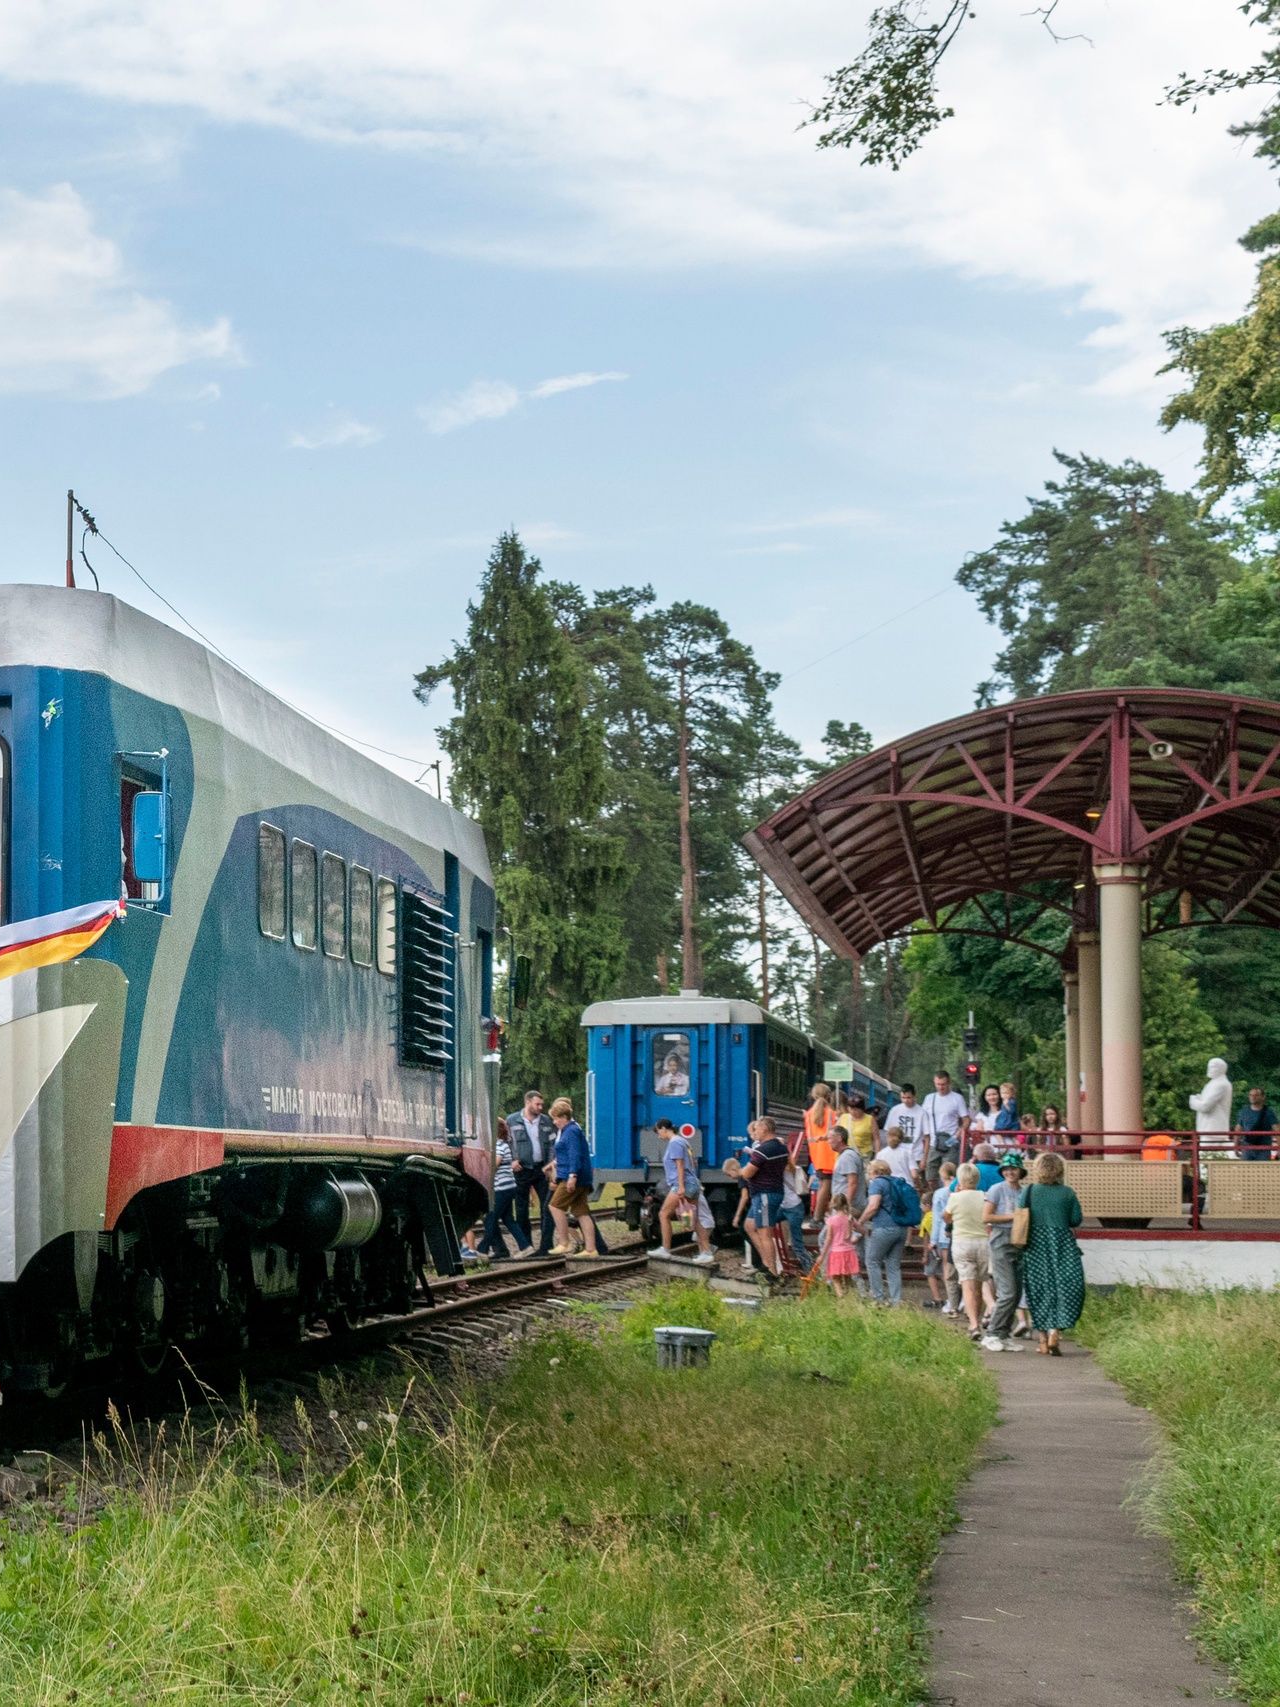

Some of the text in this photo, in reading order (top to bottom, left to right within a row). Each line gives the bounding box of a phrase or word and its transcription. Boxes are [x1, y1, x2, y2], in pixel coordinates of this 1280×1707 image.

[271, 1086, 304, 1114] МАЛАЯ
[309, 1090, 363, 1118] МОСКОВСКАЯ
[898, 1115, 915, 1126] SPI
